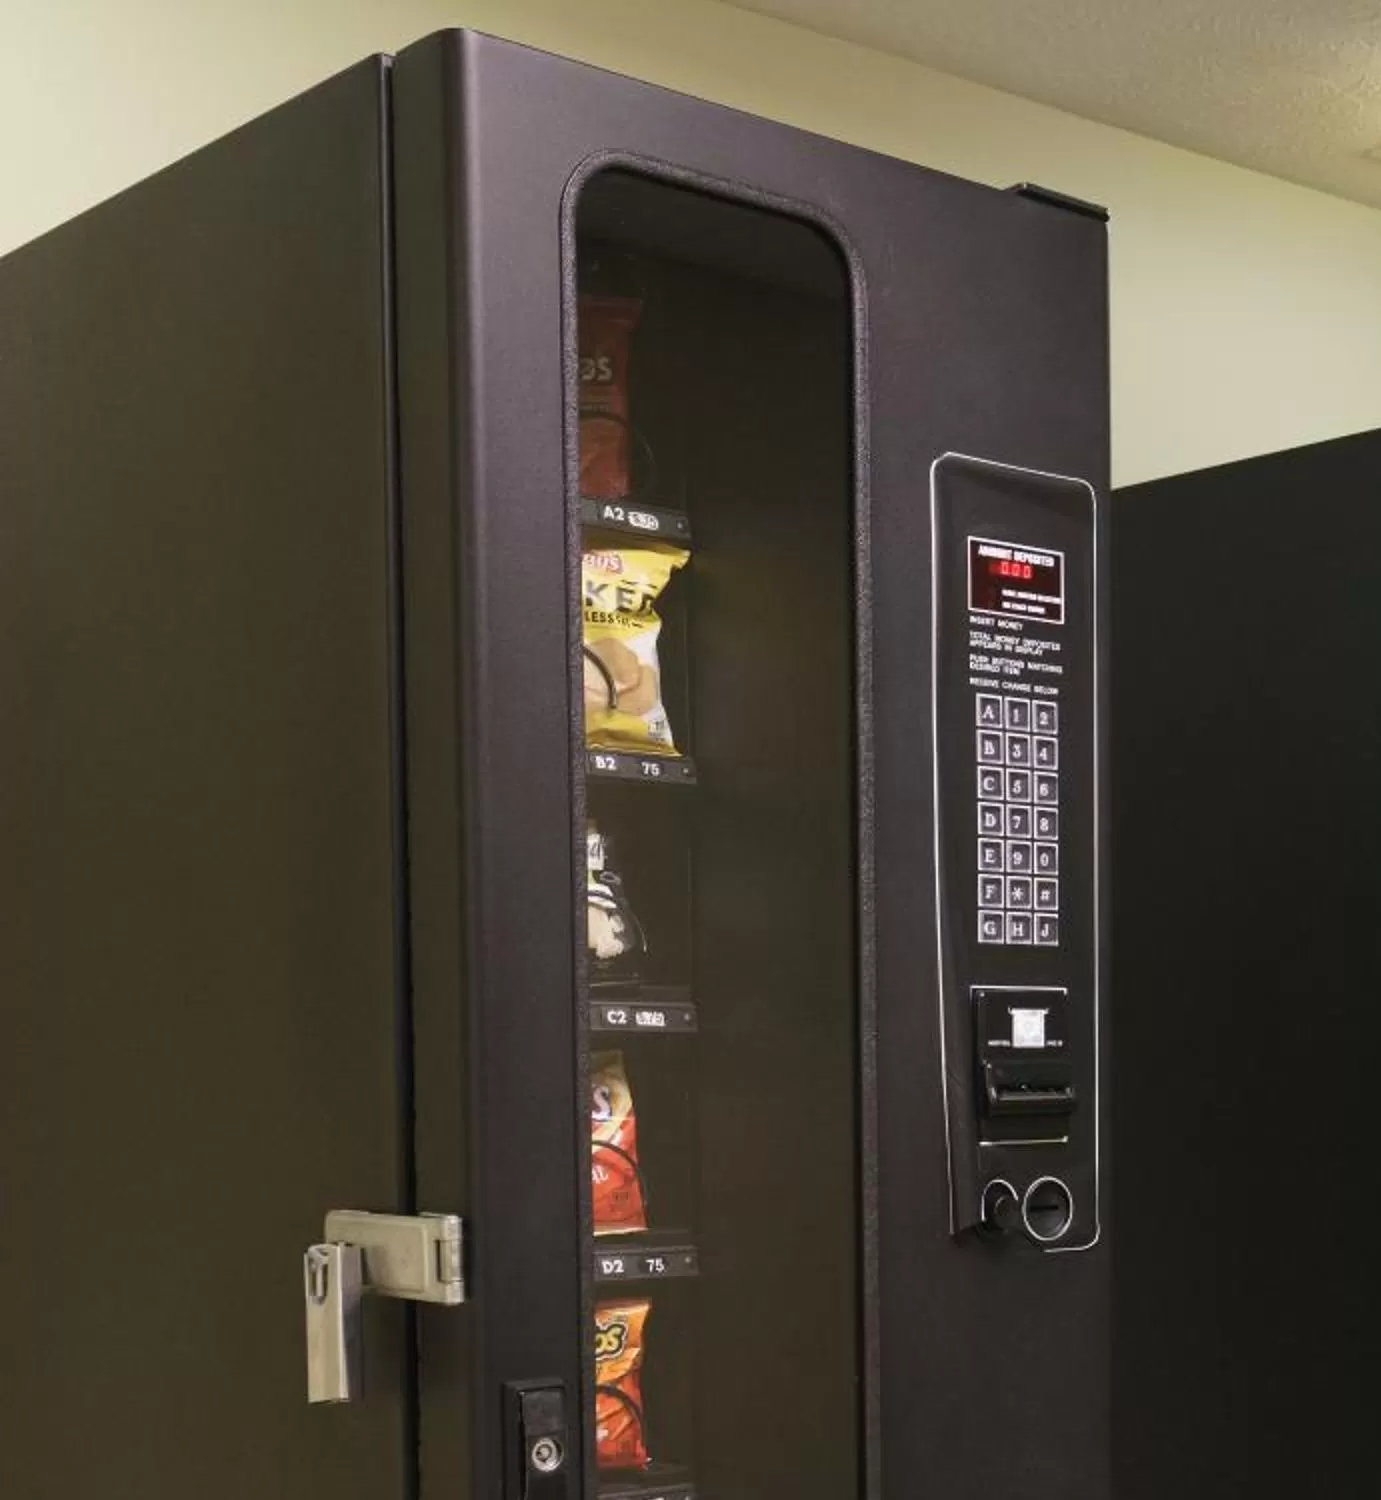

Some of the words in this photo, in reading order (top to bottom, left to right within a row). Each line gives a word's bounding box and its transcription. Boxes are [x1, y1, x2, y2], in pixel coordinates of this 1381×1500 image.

[603, 505, 625, 521] A2
[997, 619, 1023, 631] MONEY
[982, 704, 995, 719] A
[1012, 708, 1021, 723] 1
[1039, 711, 1049, 725] 2
[983, 740, 996, 756] B
[1012, 743, 1022, 759] 3
[1039, 746, 1048, 761] 4
[594, 755, 617, 770] B2
[641, 761, 660, 776] 75
[982, 776, 995, 791] C
[1012, 779, 1022, 795] 5
[1039, 783, 1049, 797] 6
[984, 812, 997, 827] D
[1012, 815, 1022, 830] 7
[1039, 817, 1049, 832] 8
[984, 849, 996, 864] E
[1012, 851, 1023, 866] 9
[984, 884, 996, 899] F
[983, 921, 997, 936] G
[1012, 922, 1024, 937] H
[1040, 923, 1049, 938] J
[607, 1009, 628, 1025] C2
[601, 1259, 625, 1274] D2
[645, 1258, 666, 1273] 75
